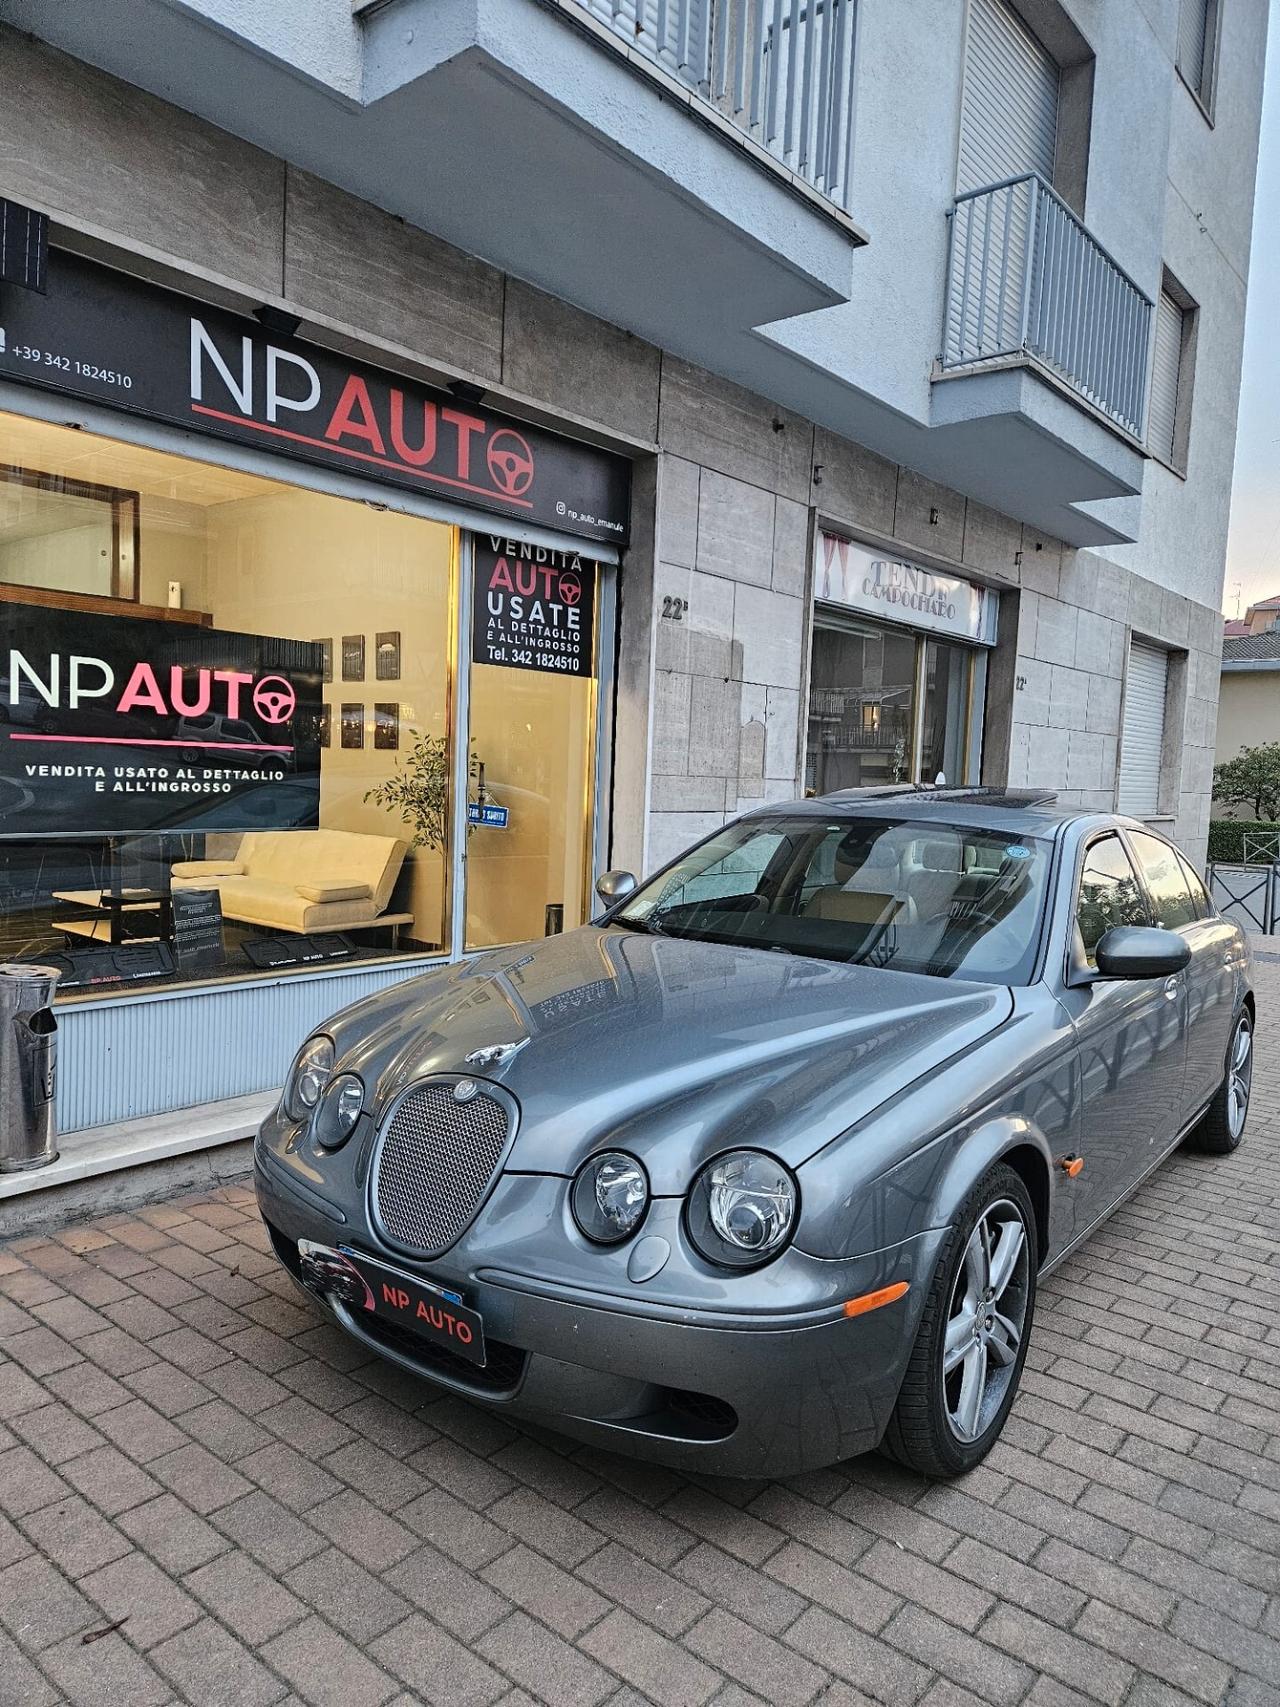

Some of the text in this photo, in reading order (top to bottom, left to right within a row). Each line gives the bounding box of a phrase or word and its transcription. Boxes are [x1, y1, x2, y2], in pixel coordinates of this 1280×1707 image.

[12, 345, 132, 389] +39 342 1824510
[489, 537, 582, 572] VENDITA
[488, 556, 582, 606] AUTO
[487, 590, 581, 630] USATE
[487, 617, 581, 643] AL DETTAGLIO
[487, 631, 581, 654] E ALL'INGROSSO
[487, 645, 580, 672] Tel. 342 1824510
[25, 764, 285, 782] VENDITA USATO AL DETTAGLIO
[95, 781, 232, 793] E ALL'INGROSSO
[382, 1282, 473, 1344] NP AUTO
